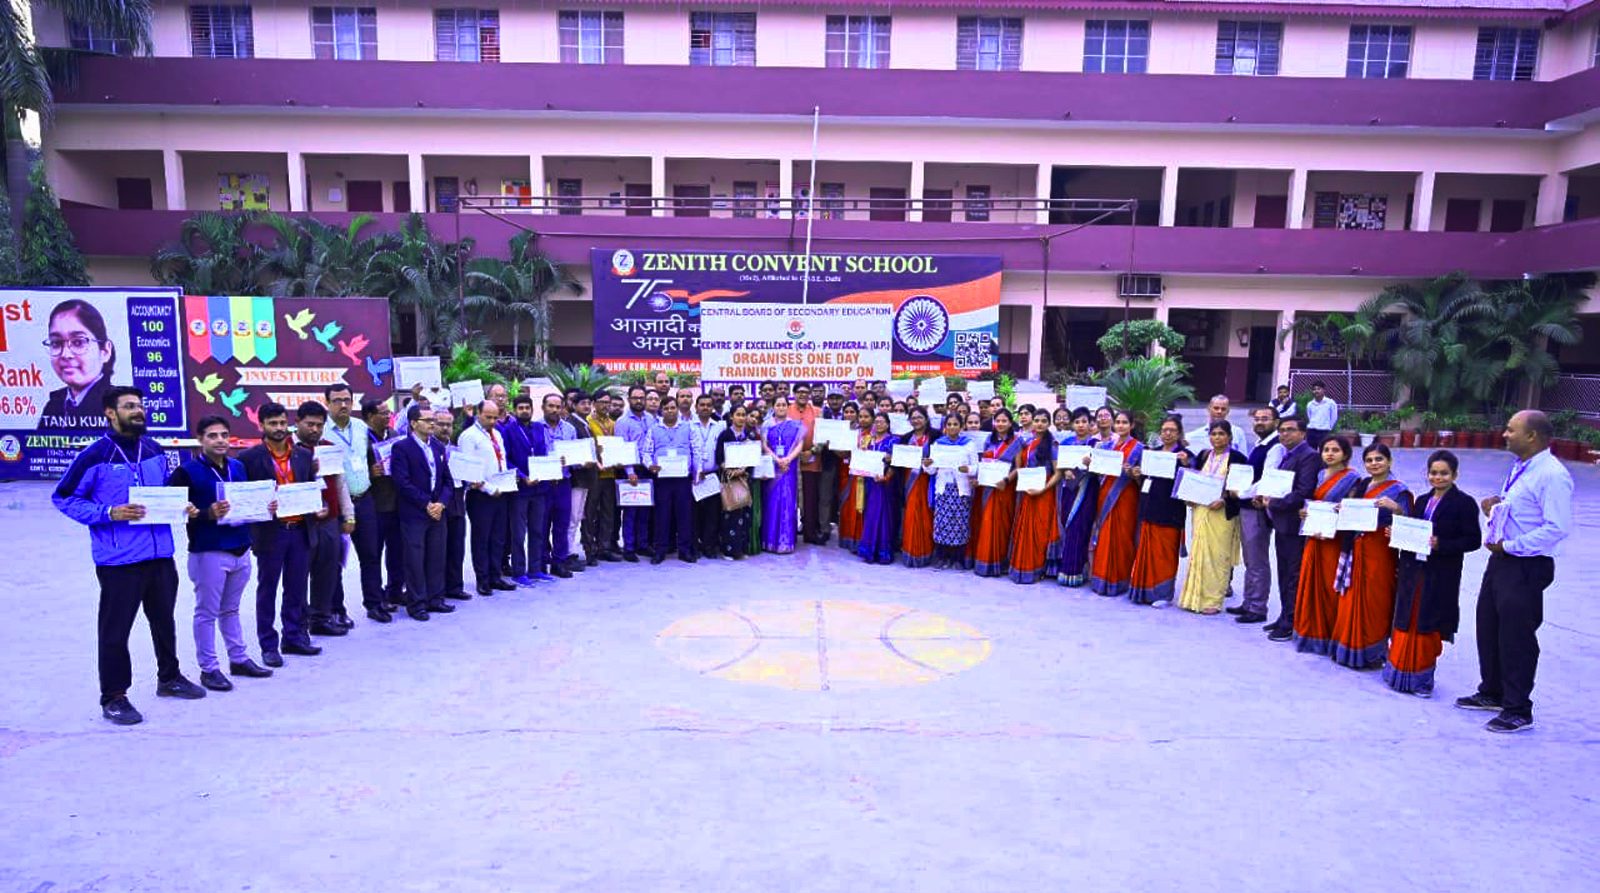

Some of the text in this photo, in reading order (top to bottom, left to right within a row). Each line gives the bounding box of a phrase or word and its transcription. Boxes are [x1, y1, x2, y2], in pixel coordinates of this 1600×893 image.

[642, 253, 938, 274] ZENITH CONVENT SCHOOL
[701, 308, 891, 316] CENTRAL BOARD OF SECONDARY EDUCATION
[142, 321, 164, 332] 100
[610, 314, 687, 334] आज़ादी
[137, 336, 170, 347] Economics
[632, 336, 686, 356] अमृत
[701, 341, 732, 350] CENTRE
[733, 341, 744, 350] OF
[745, 341, 793, 350] EXCELLENCE
[147, 352, 163, 362] 96
[733, 353, 860, 365] ORGANISES ONE DAY
[245, 370, 338, 382] INVESTITURE
[718, 366, 874, 378] TRAINING WORKSHOP ON
[149, 382, 164, 393] 96
[0, 396, 36, 416] 6.6%
[142, 397, 174, 410] English
[43, 415, 109, 427] TANU KUM
[151, 412, 166, 423] 90
[26, 435, 70, 448] ZENITH
